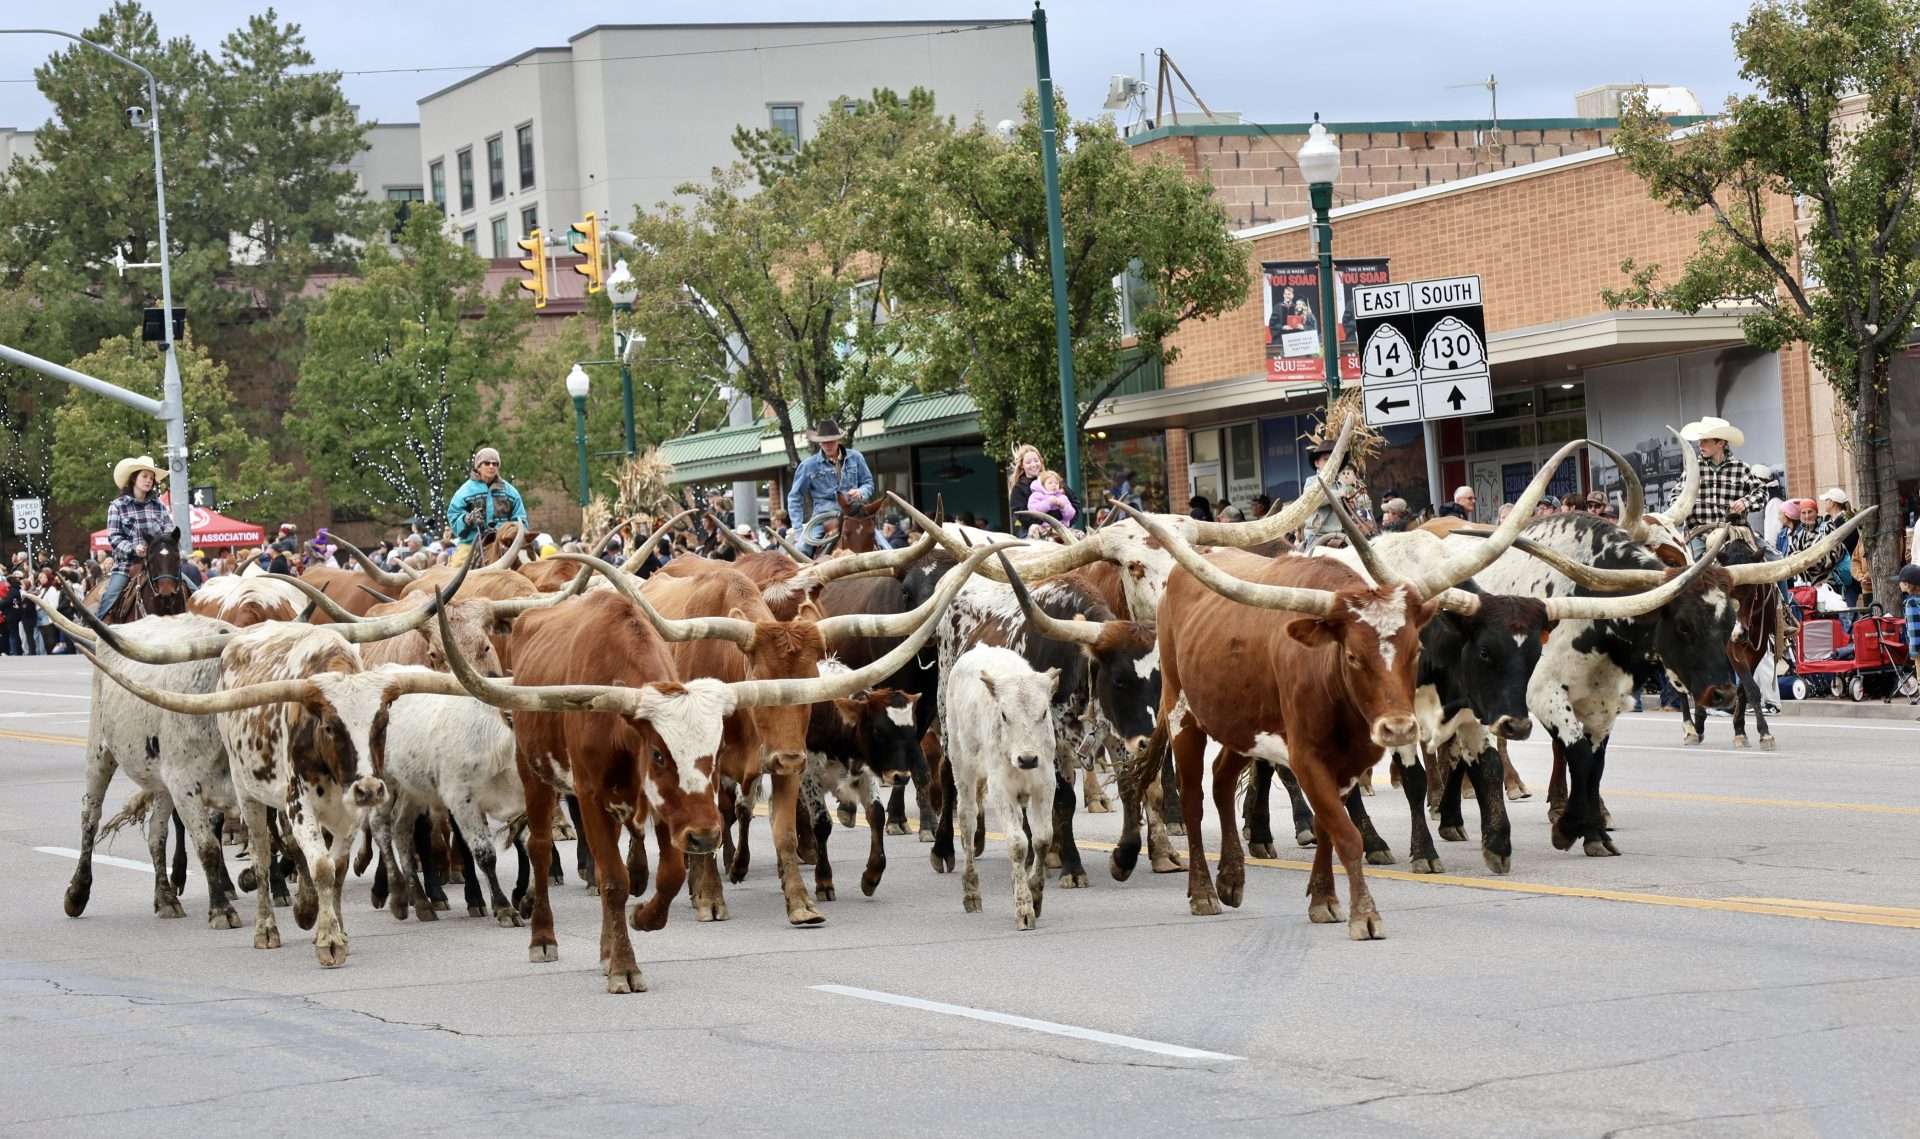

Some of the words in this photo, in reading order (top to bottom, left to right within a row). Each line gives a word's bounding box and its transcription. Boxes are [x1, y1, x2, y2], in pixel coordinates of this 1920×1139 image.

[1267, 274, 1287, 287] YOU
[1288, 273, 1317, 286] SOAR
[1359, 271, 1388, 284] SOAR
[1421, 282, 1473, 305] SOUTH
[1363, 290, 1401, 312] EAST
[1431, 334, 1471, 359] 130
[1375, 342, 1400, 366] 14
[1273, 360, 1296, 372] SUU
[1348, 357, 1361, 369] SU
[17, 517, 39, 530] 30
[201, 531, 259, 543] ASSOCIATION
